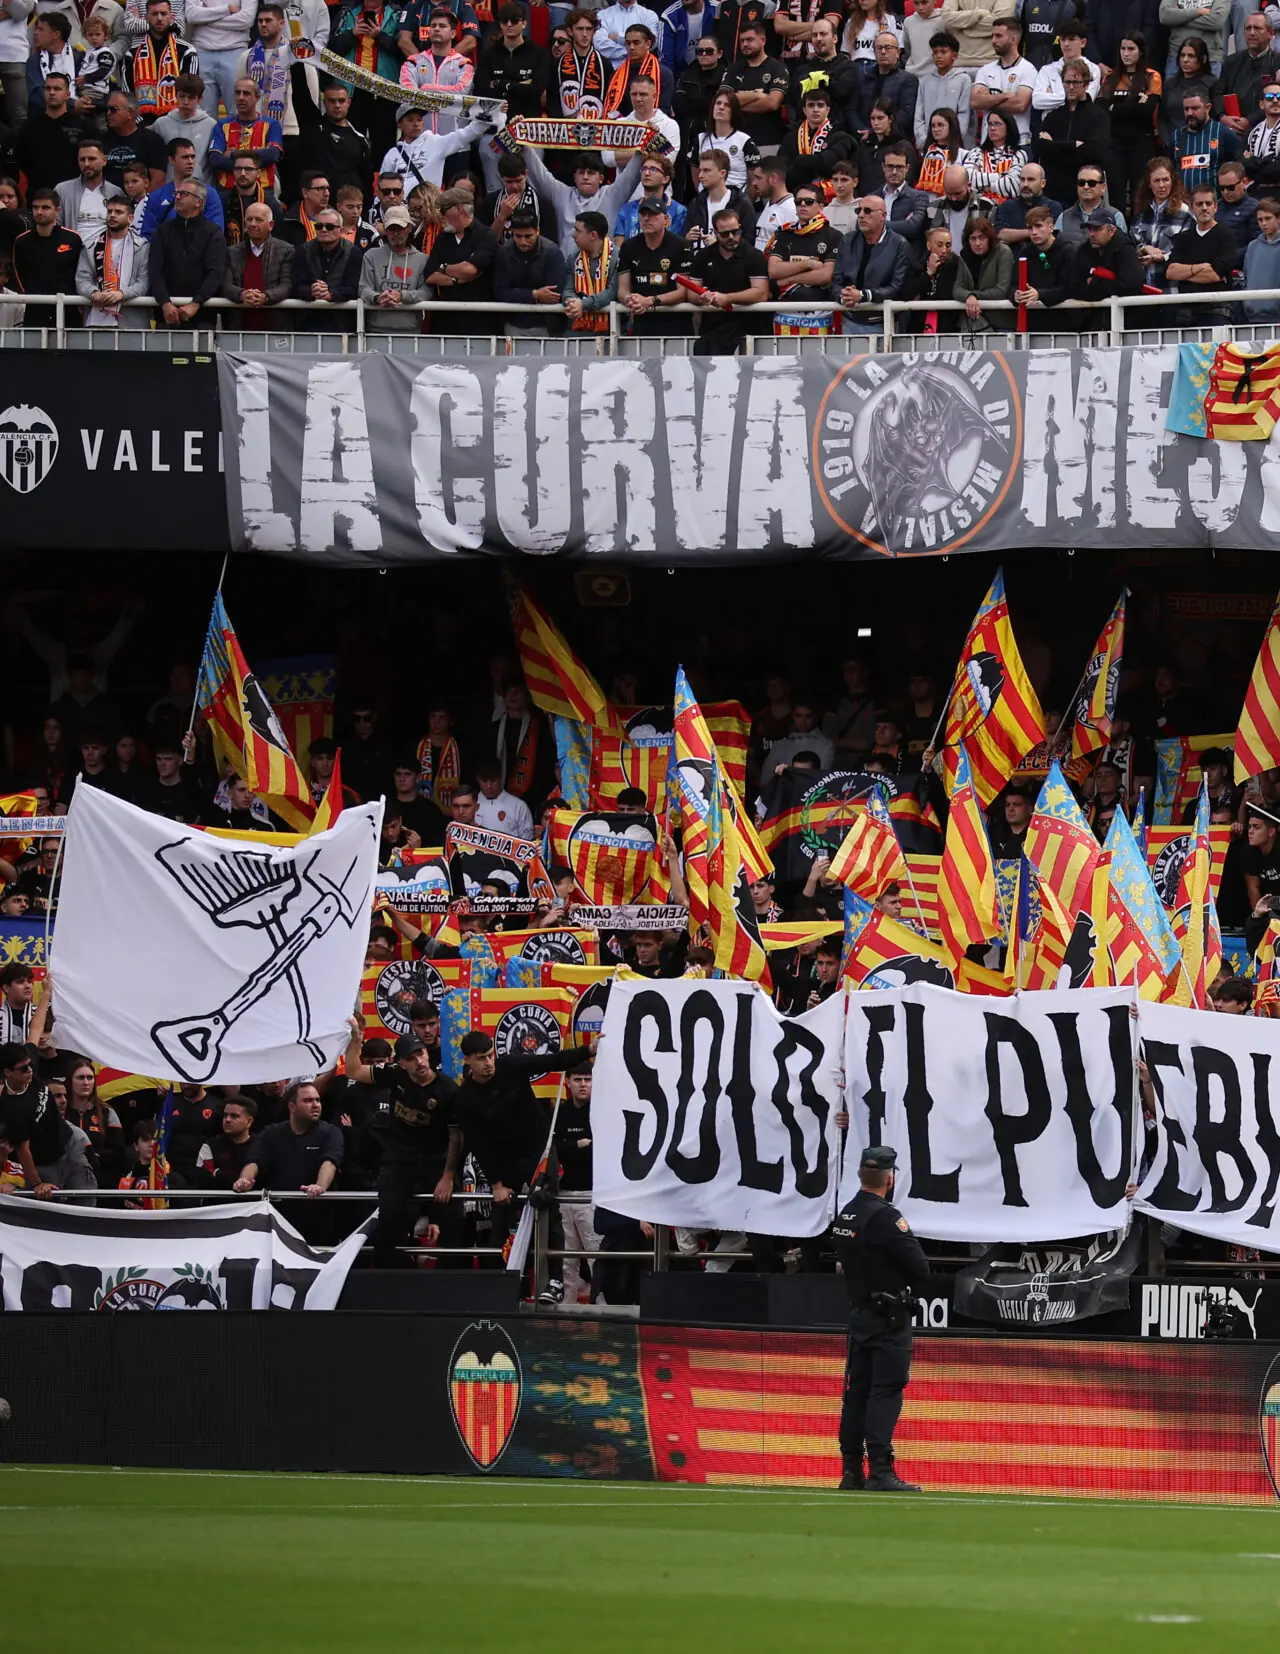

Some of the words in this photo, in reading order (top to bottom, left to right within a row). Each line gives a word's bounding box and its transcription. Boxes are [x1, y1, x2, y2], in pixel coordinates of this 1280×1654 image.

[515, 119, 571, 146] CURVA
[601, 122, 648, 148] NORD
[80, 428, 225, 473] VALE
[235, 358, 381, 552] LA
[411, 355, 815, 556] CURVA
[821, 409, 860, 502] 1919
[845, 359, 890, 402] LA
[578, 830, 631, 849] VALENCIA
[620, 990, 830, 1199] SOLO
[861, 1001, 963, 1203] EL
